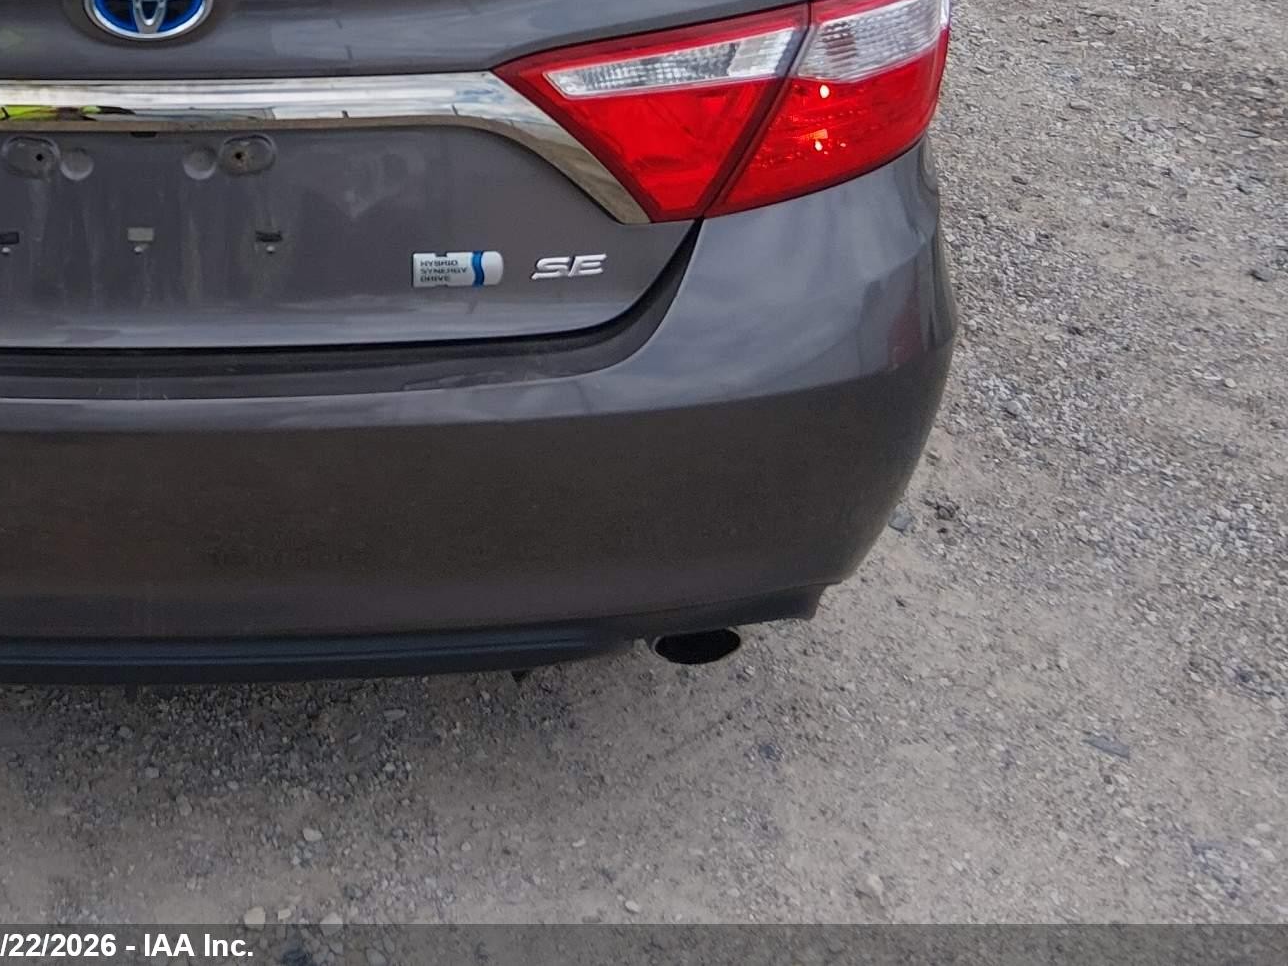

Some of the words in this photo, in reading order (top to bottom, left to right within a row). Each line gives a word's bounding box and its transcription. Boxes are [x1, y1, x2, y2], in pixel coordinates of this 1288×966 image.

[420, 259, 458, 267] HYBRID
[531, 253, 608, 281] SE
[420, 267, 467, 275] SYNERGY
[420, 275, 451, 283] DRIVE
